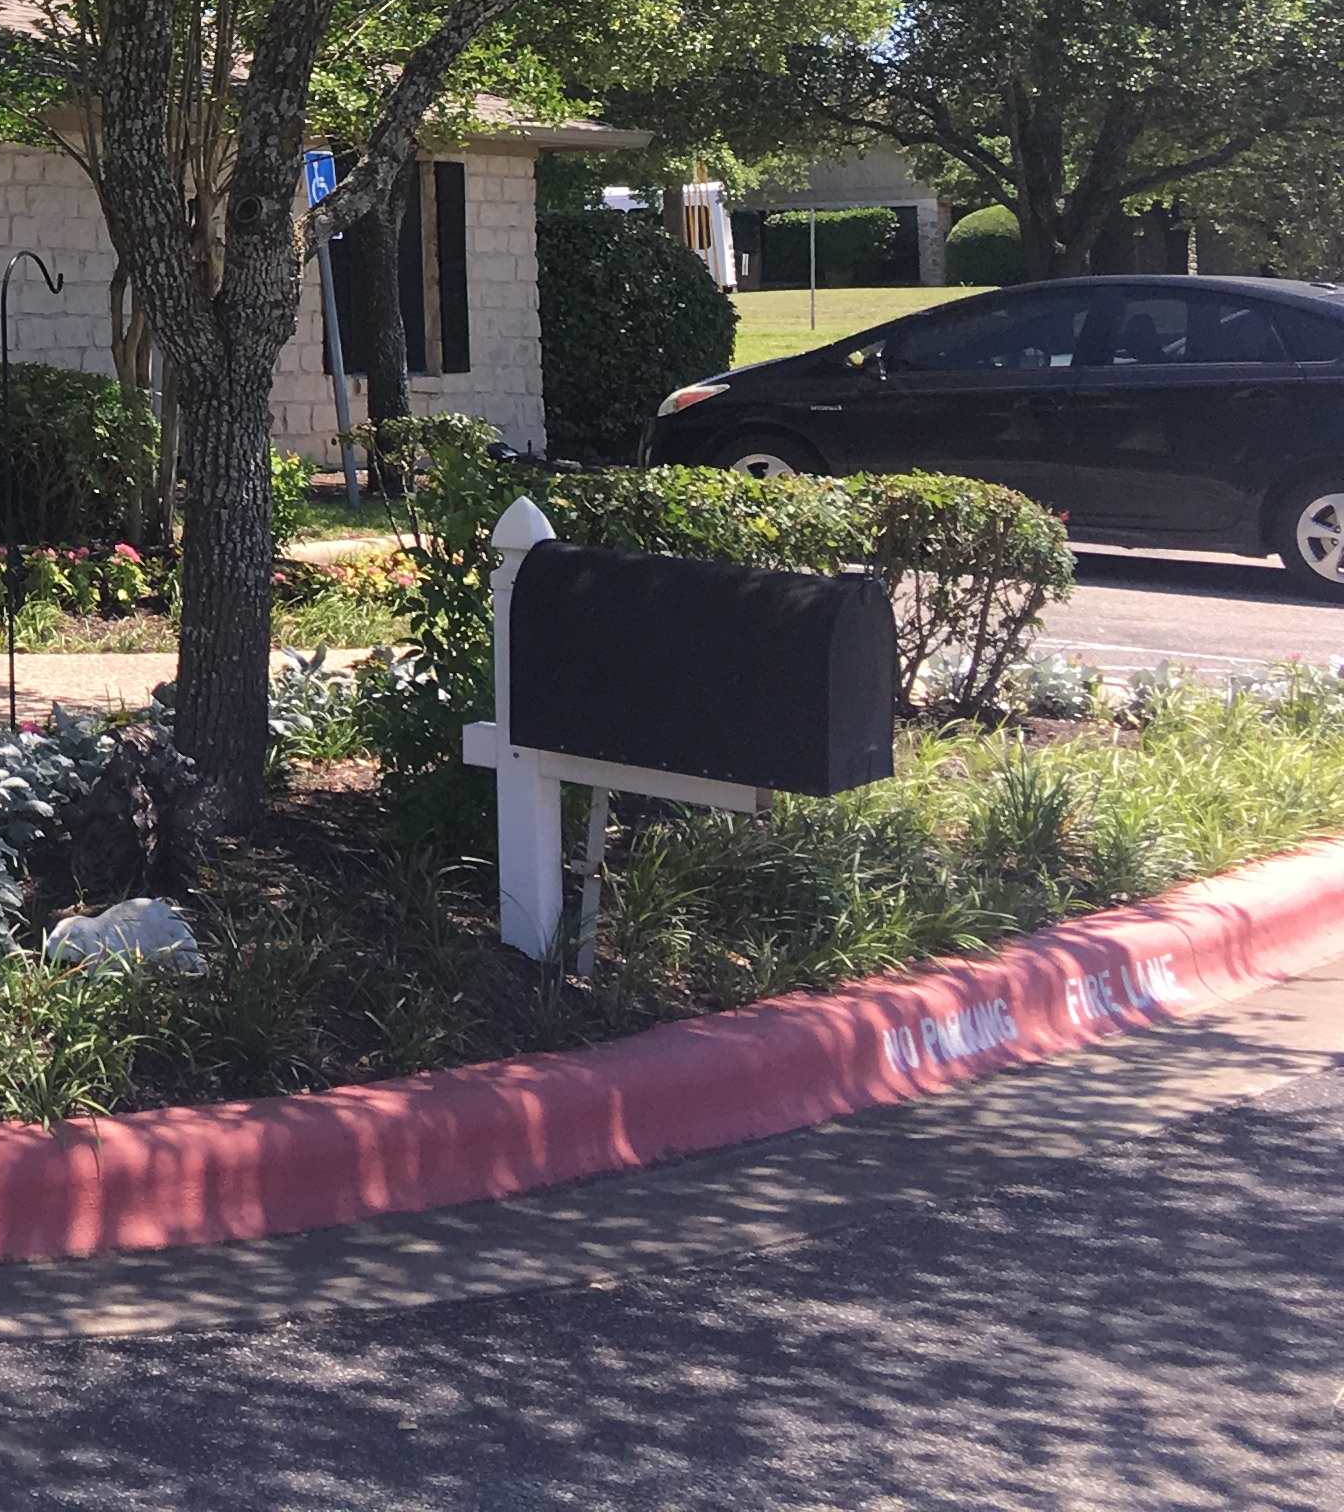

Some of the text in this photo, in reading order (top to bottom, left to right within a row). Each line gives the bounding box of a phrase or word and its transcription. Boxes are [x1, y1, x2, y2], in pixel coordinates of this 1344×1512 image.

[882, 953, 1192, 1075] NO PARKING FIRE LANE
